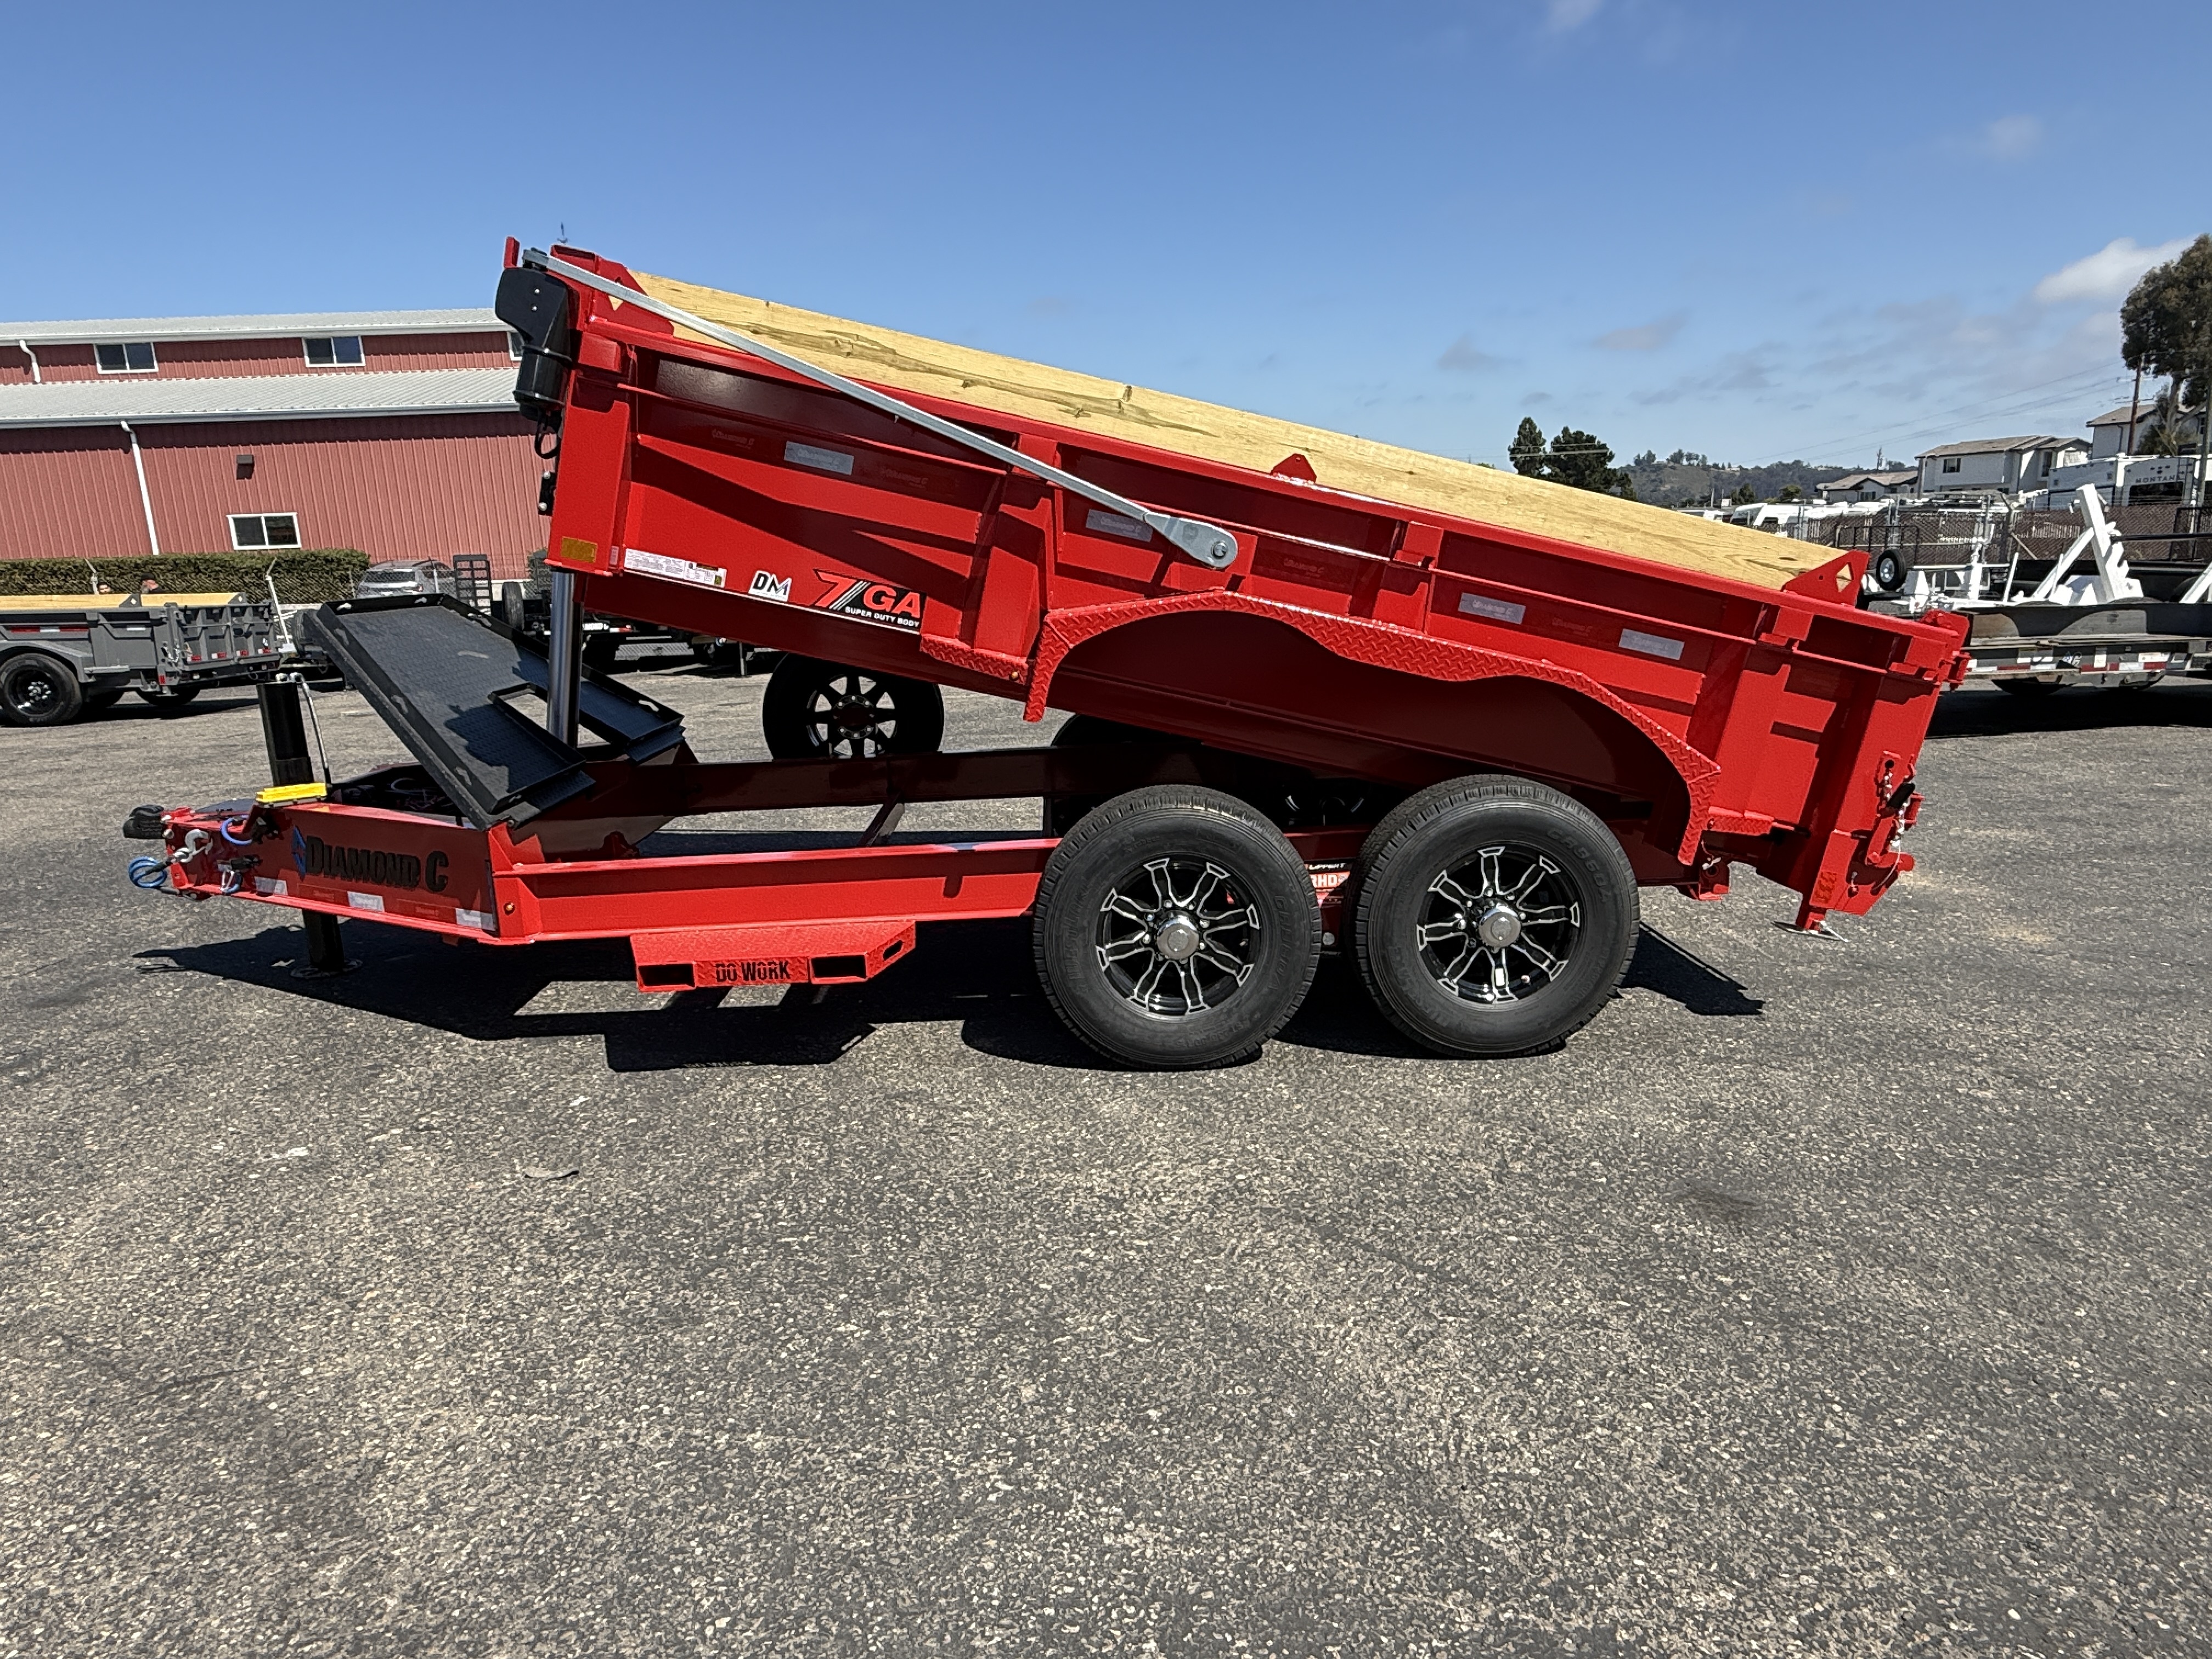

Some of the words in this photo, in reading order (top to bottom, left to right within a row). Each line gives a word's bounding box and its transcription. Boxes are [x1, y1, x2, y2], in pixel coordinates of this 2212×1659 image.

[2135, 475, 2180, 483] MONTAN
[753, 573, 789, 596] DM
[845, 606, 872, 618] SUPER
[873, 613, 896, 623] DUTY
[897, 617, 920, 627] BODY
[306, 835, 421, 891] DIAMOND
[425, 850, 450, 893] C
[715, 963, 737, 982] DO
[741, 960, 791, 981] WORK
